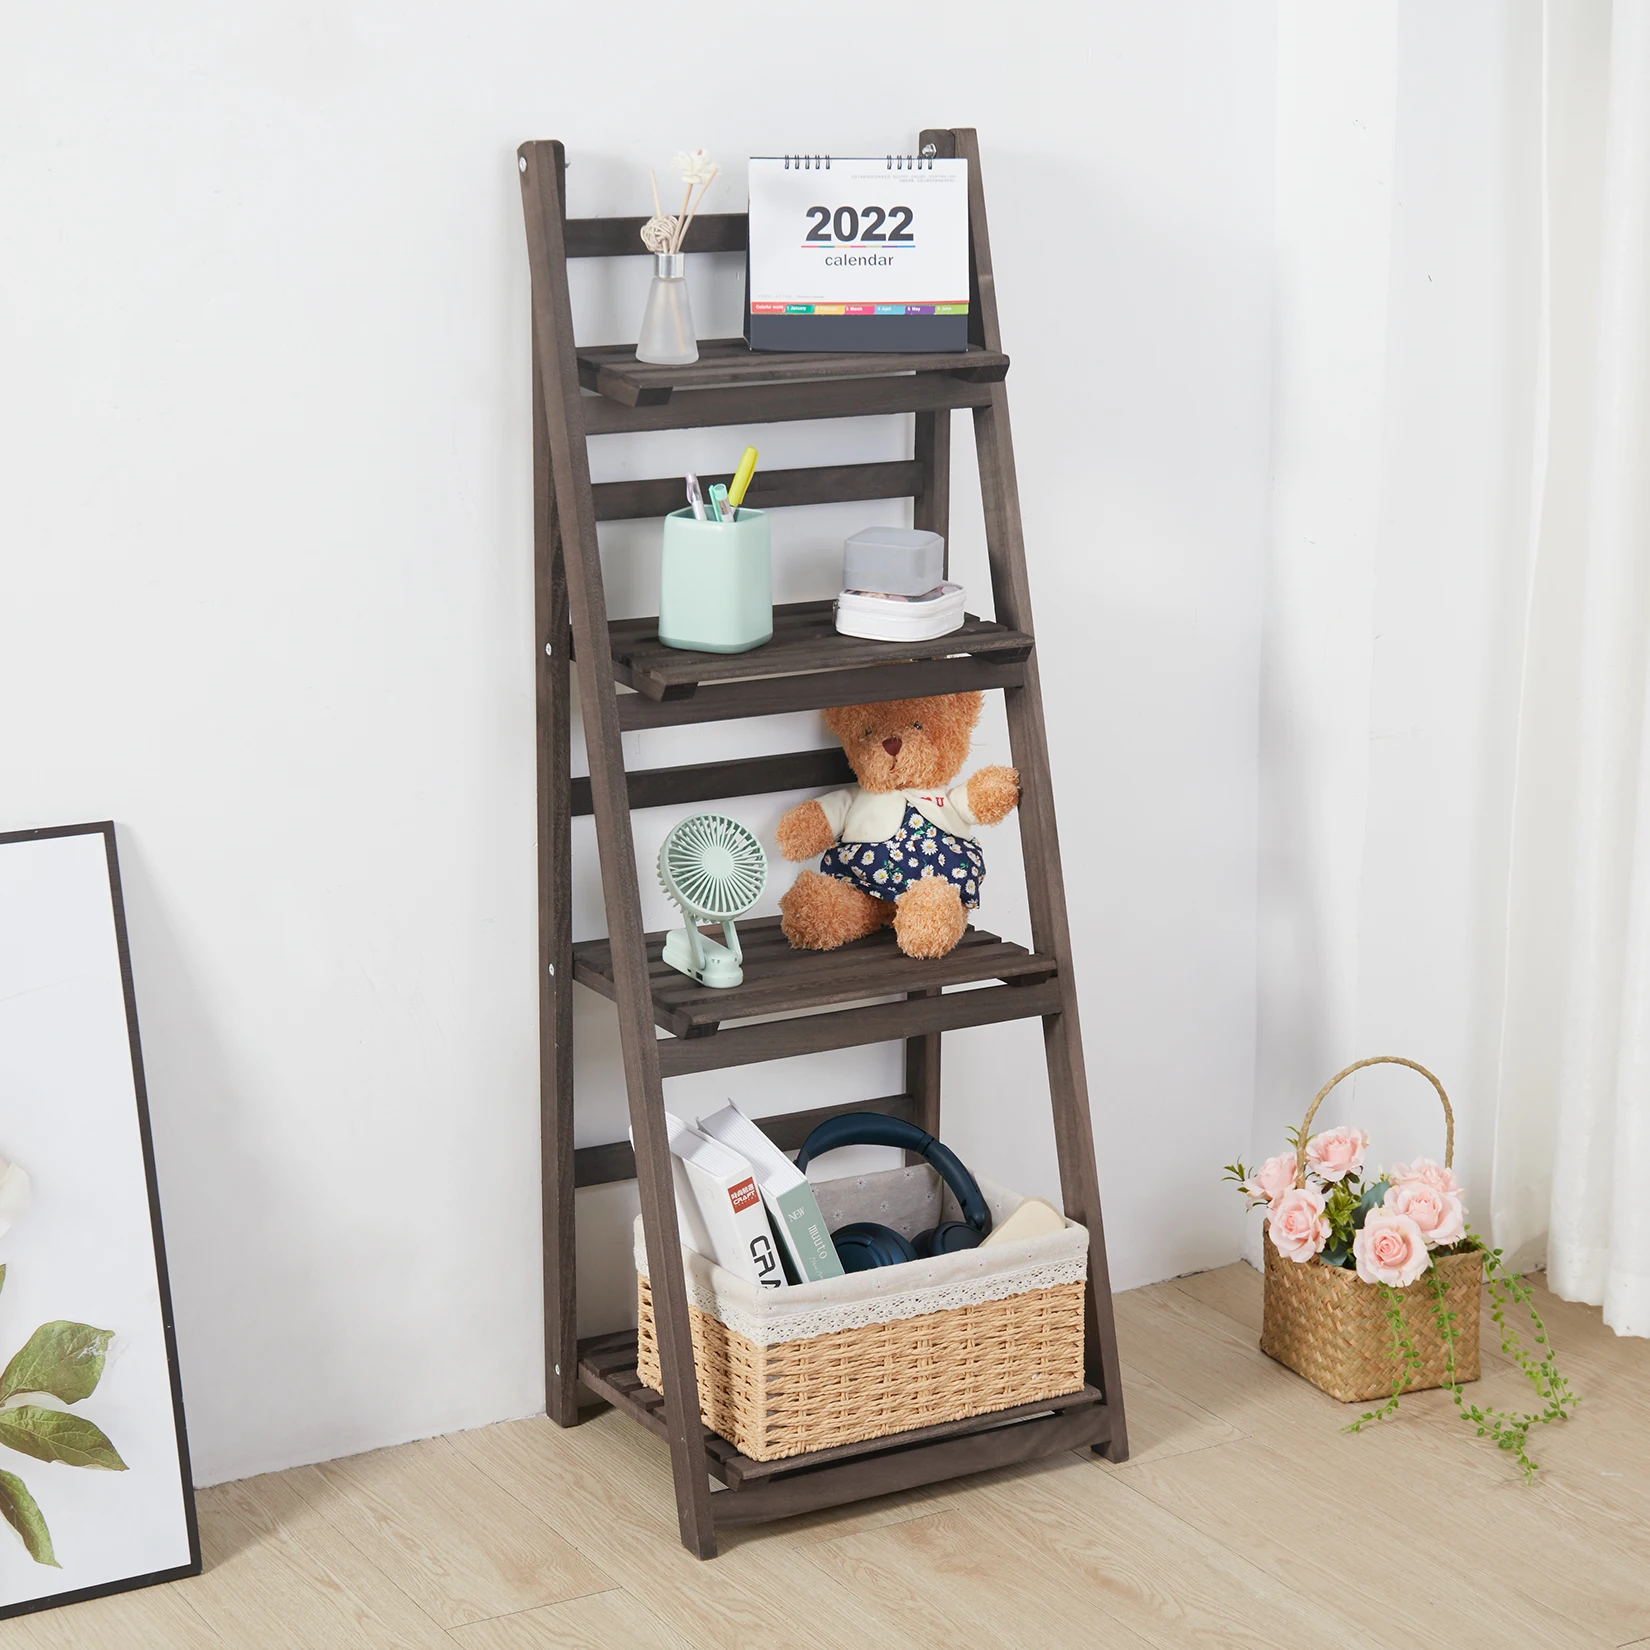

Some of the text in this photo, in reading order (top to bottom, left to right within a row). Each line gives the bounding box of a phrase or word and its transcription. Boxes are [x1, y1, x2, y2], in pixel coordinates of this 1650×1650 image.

[805, 206, 914, 242] 2022
[825, 254, 894, 266] calendar
[935, 797, 944, 807] U
[733, 1190, 755, 1205] CRAFT
[788, 1207, 805, 1222] NEW
[808, 1225, 828, 1259] muuto
